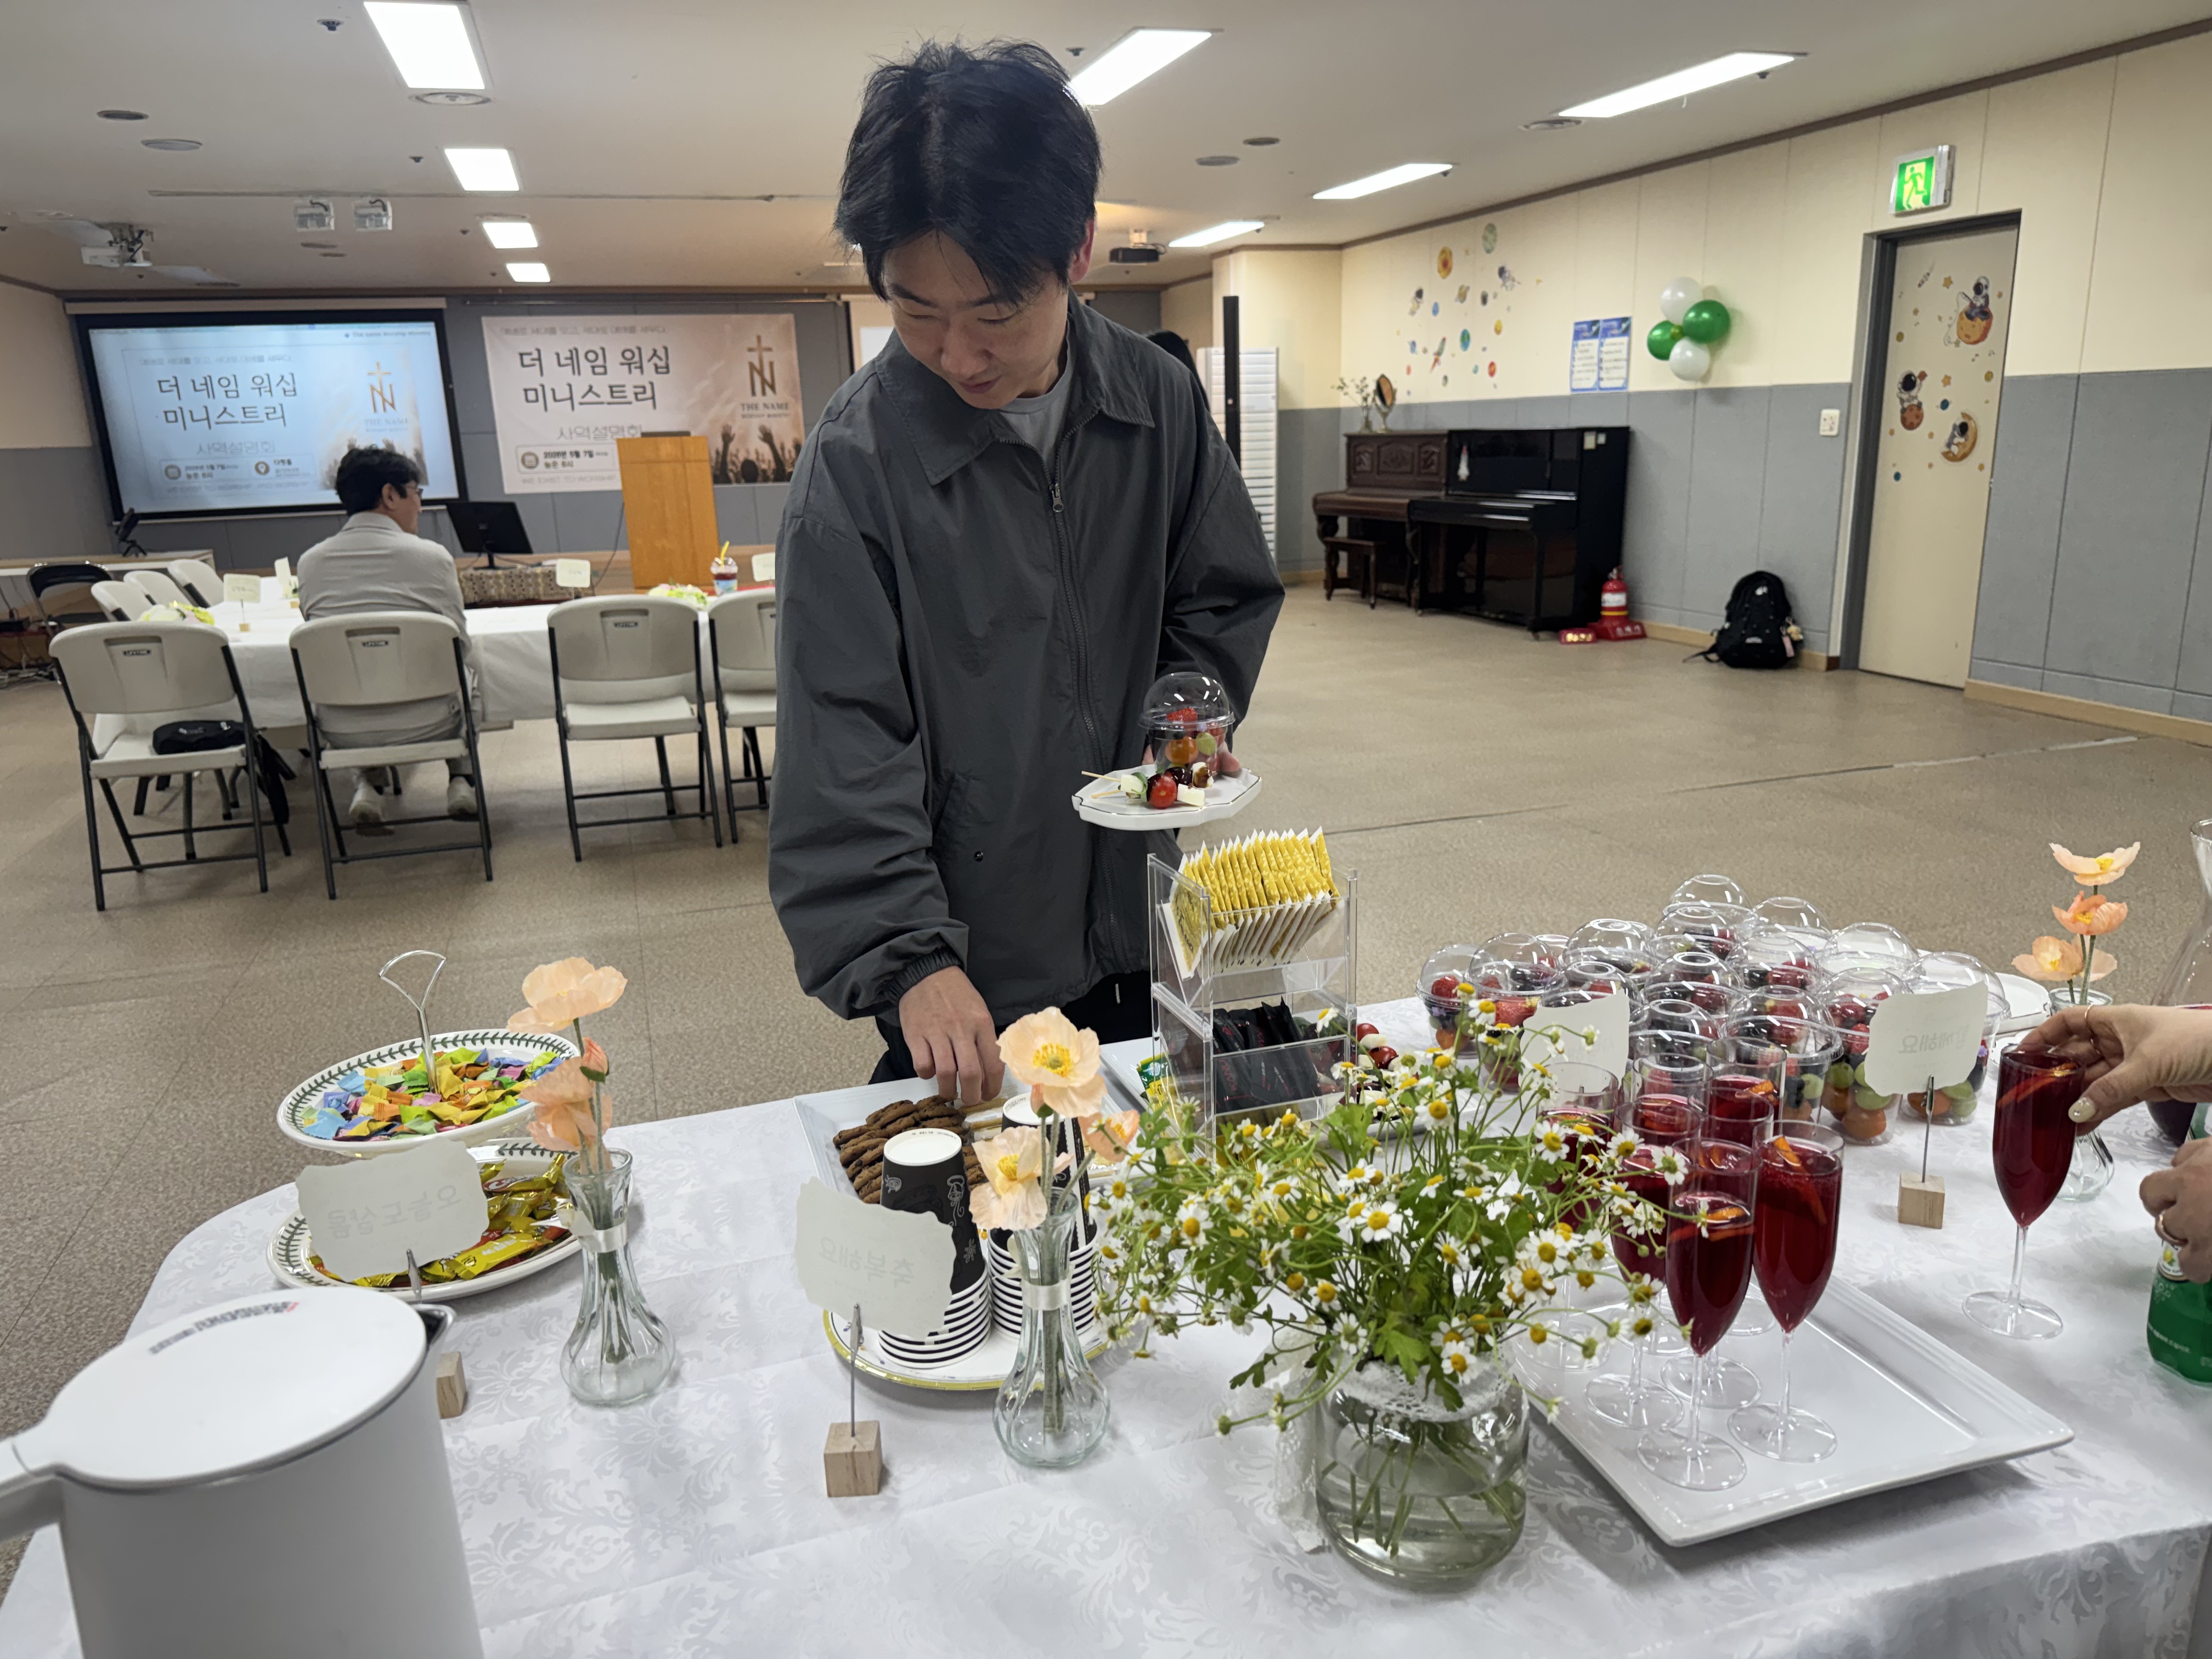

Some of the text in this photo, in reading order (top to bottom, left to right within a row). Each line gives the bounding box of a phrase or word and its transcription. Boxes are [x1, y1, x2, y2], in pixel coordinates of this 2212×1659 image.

[518, 345, 670, 377] 더 네임 워십
[156, 372, 297, 401] 더 네임 워십
[523, 380, 657, 413] 미니스트리
[162, 403, 287, 431] 미니스트리
